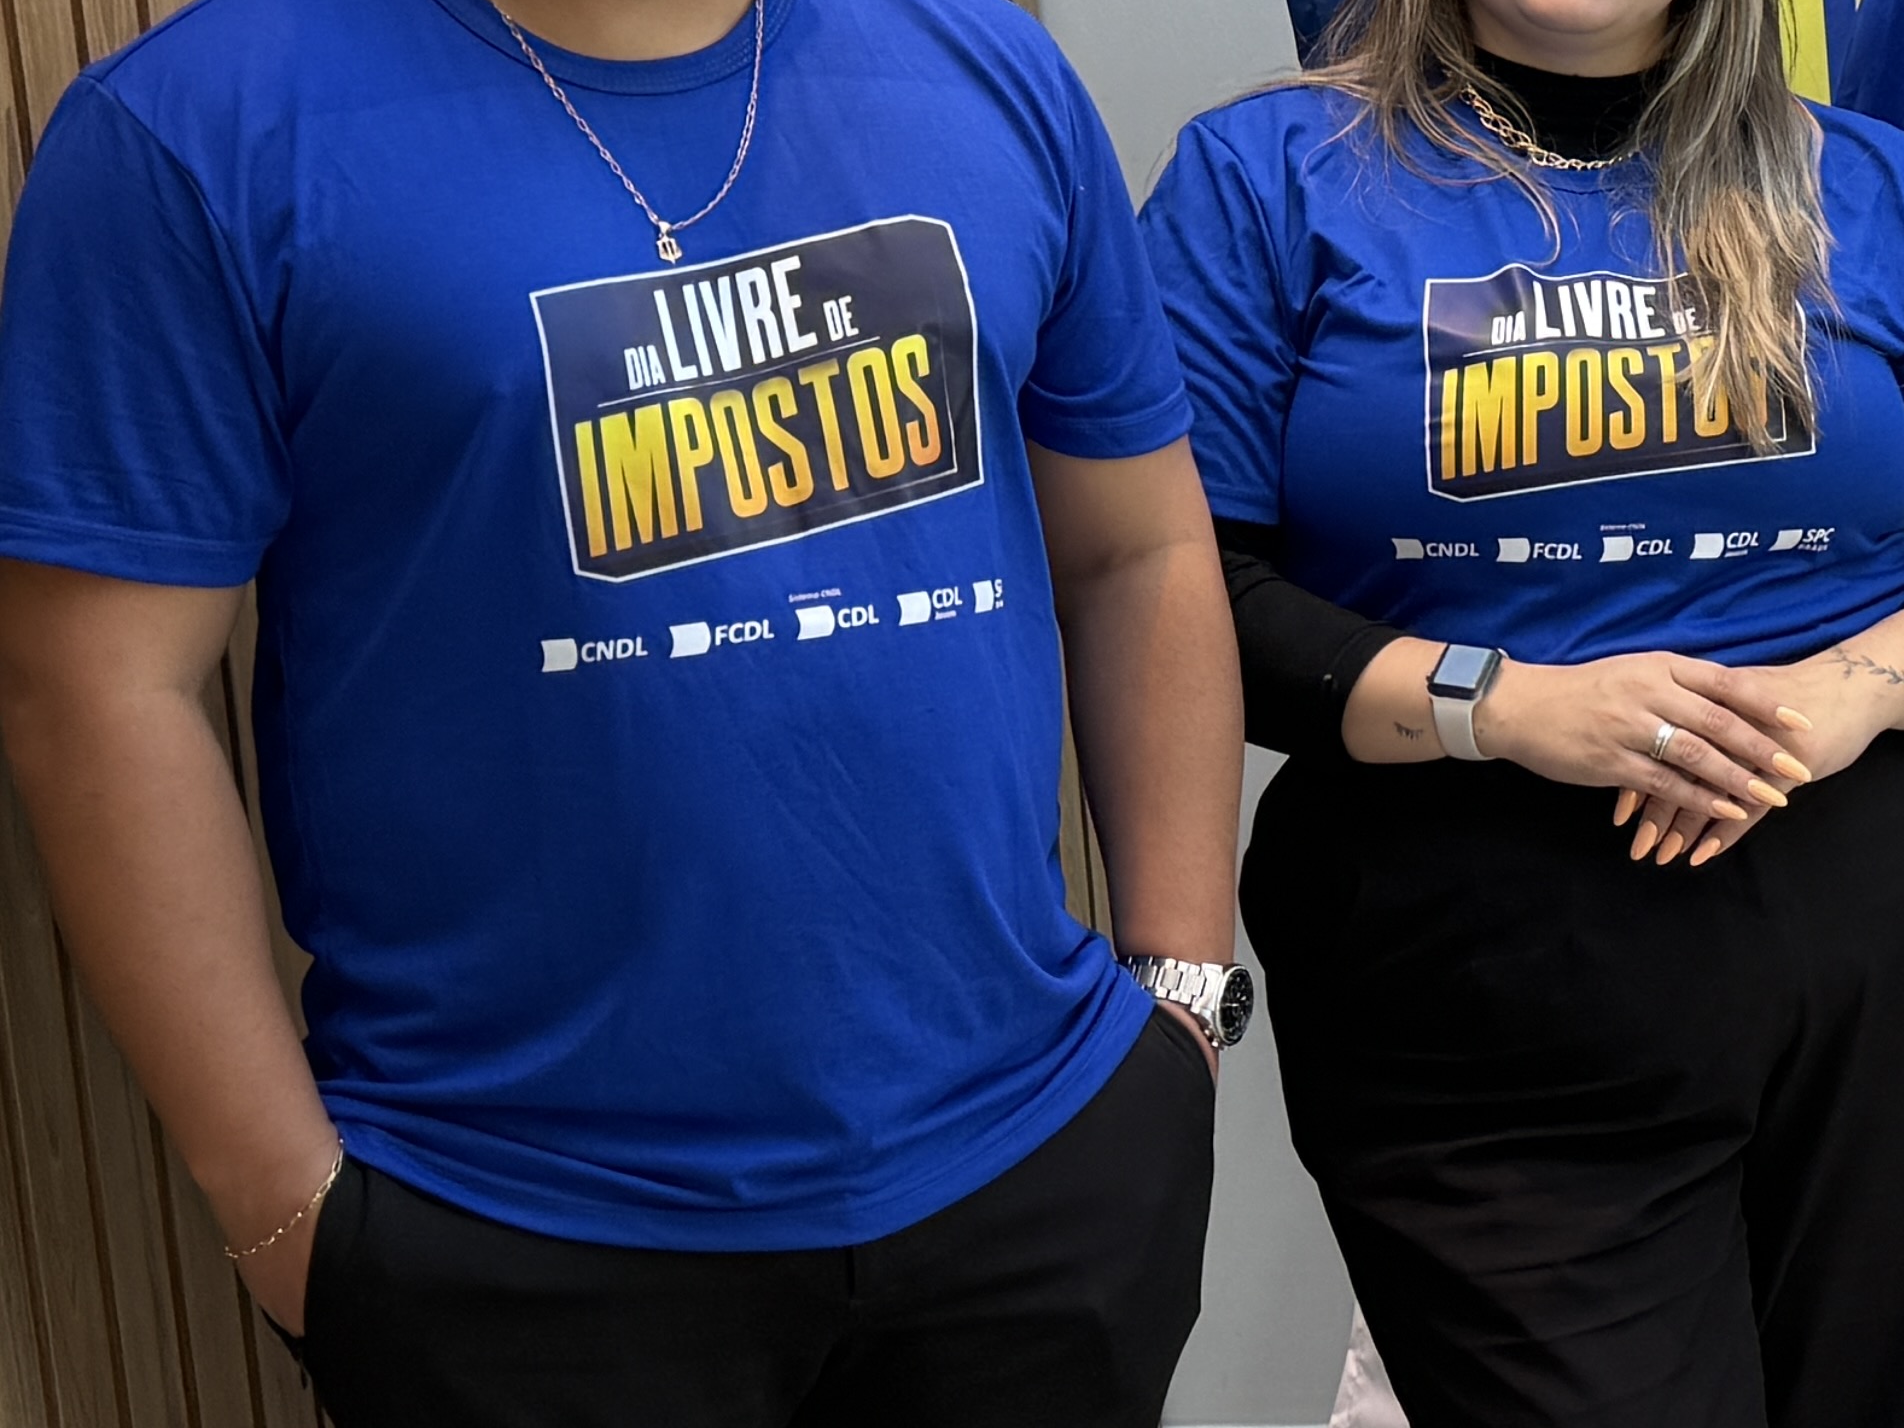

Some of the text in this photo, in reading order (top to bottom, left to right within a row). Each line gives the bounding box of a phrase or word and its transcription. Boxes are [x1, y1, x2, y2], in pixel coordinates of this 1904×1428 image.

[623, 255, 859, 390] DIA LIVRE DE
[1491, 311, 1526, 345] DIA
[1532, 281, 1665, 340] LIVRE
[575, 334, 942, 557] IMPOSTOS
[1426, 528, 1834, 560] CNDL FCDL CDL CDL SPC
[581, 586, 962, 662] CNDL FCDL CDL CDL
